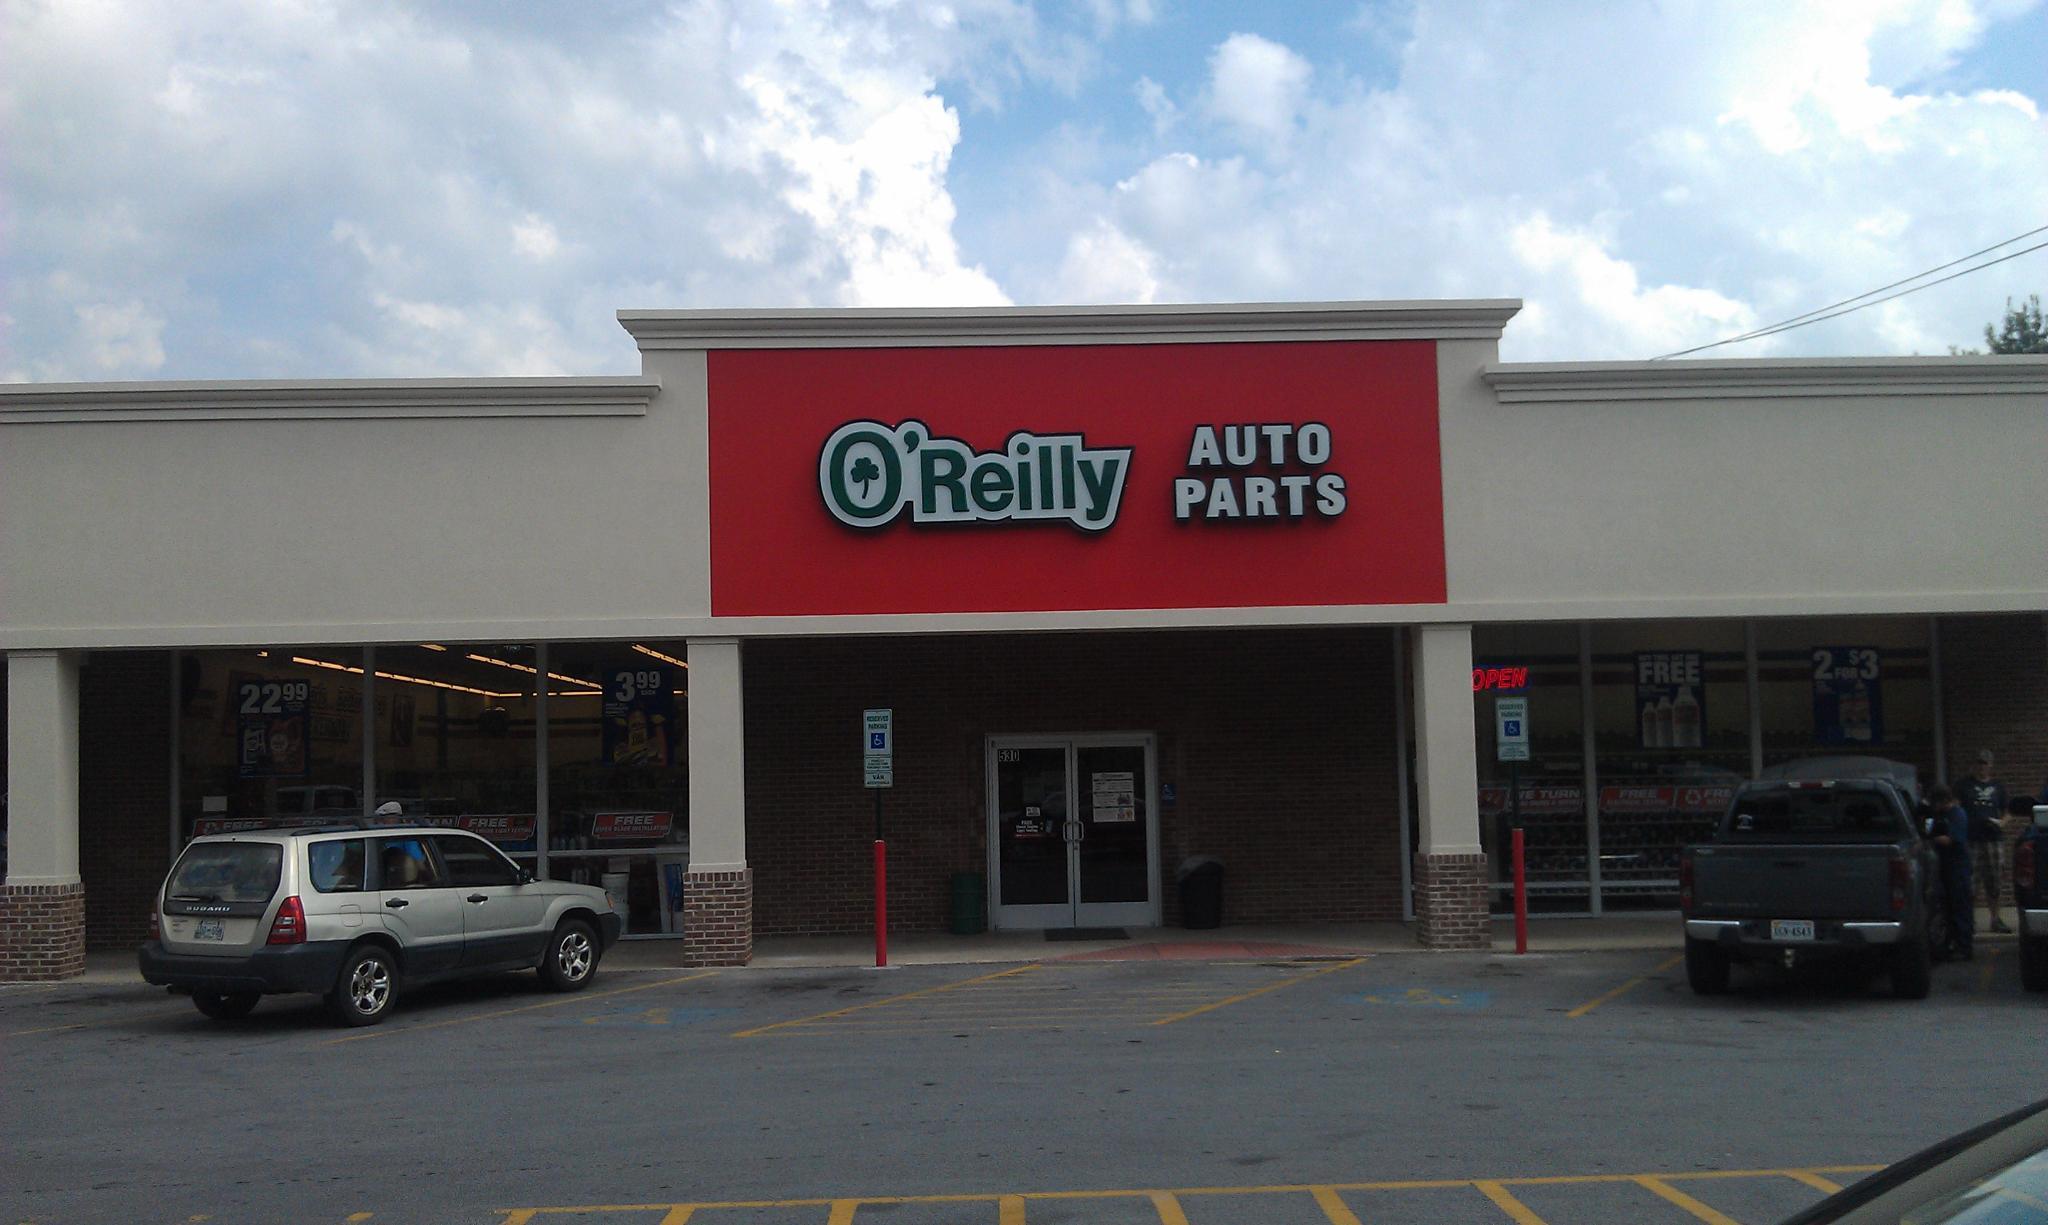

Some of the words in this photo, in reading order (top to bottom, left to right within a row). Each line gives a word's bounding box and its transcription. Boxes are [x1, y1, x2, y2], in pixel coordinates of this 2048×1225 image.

[1188, 423, 1331, 467] AUTO
[821, 422, 1130, 527] O'Reilly
[1175, 473, 1347, 519] PARTS
[1638, 655, 1700, 684] FREE
[1472, 667, 1528, 691] OPEN
[1538, 789, 1580, 799] TURN
[1619, 789, 1657, 799] FREE
[1704, 788, 1733, 799] FRE
[468, 818, 509, 828] FREE
[614, 815, 656, 825] FREE
